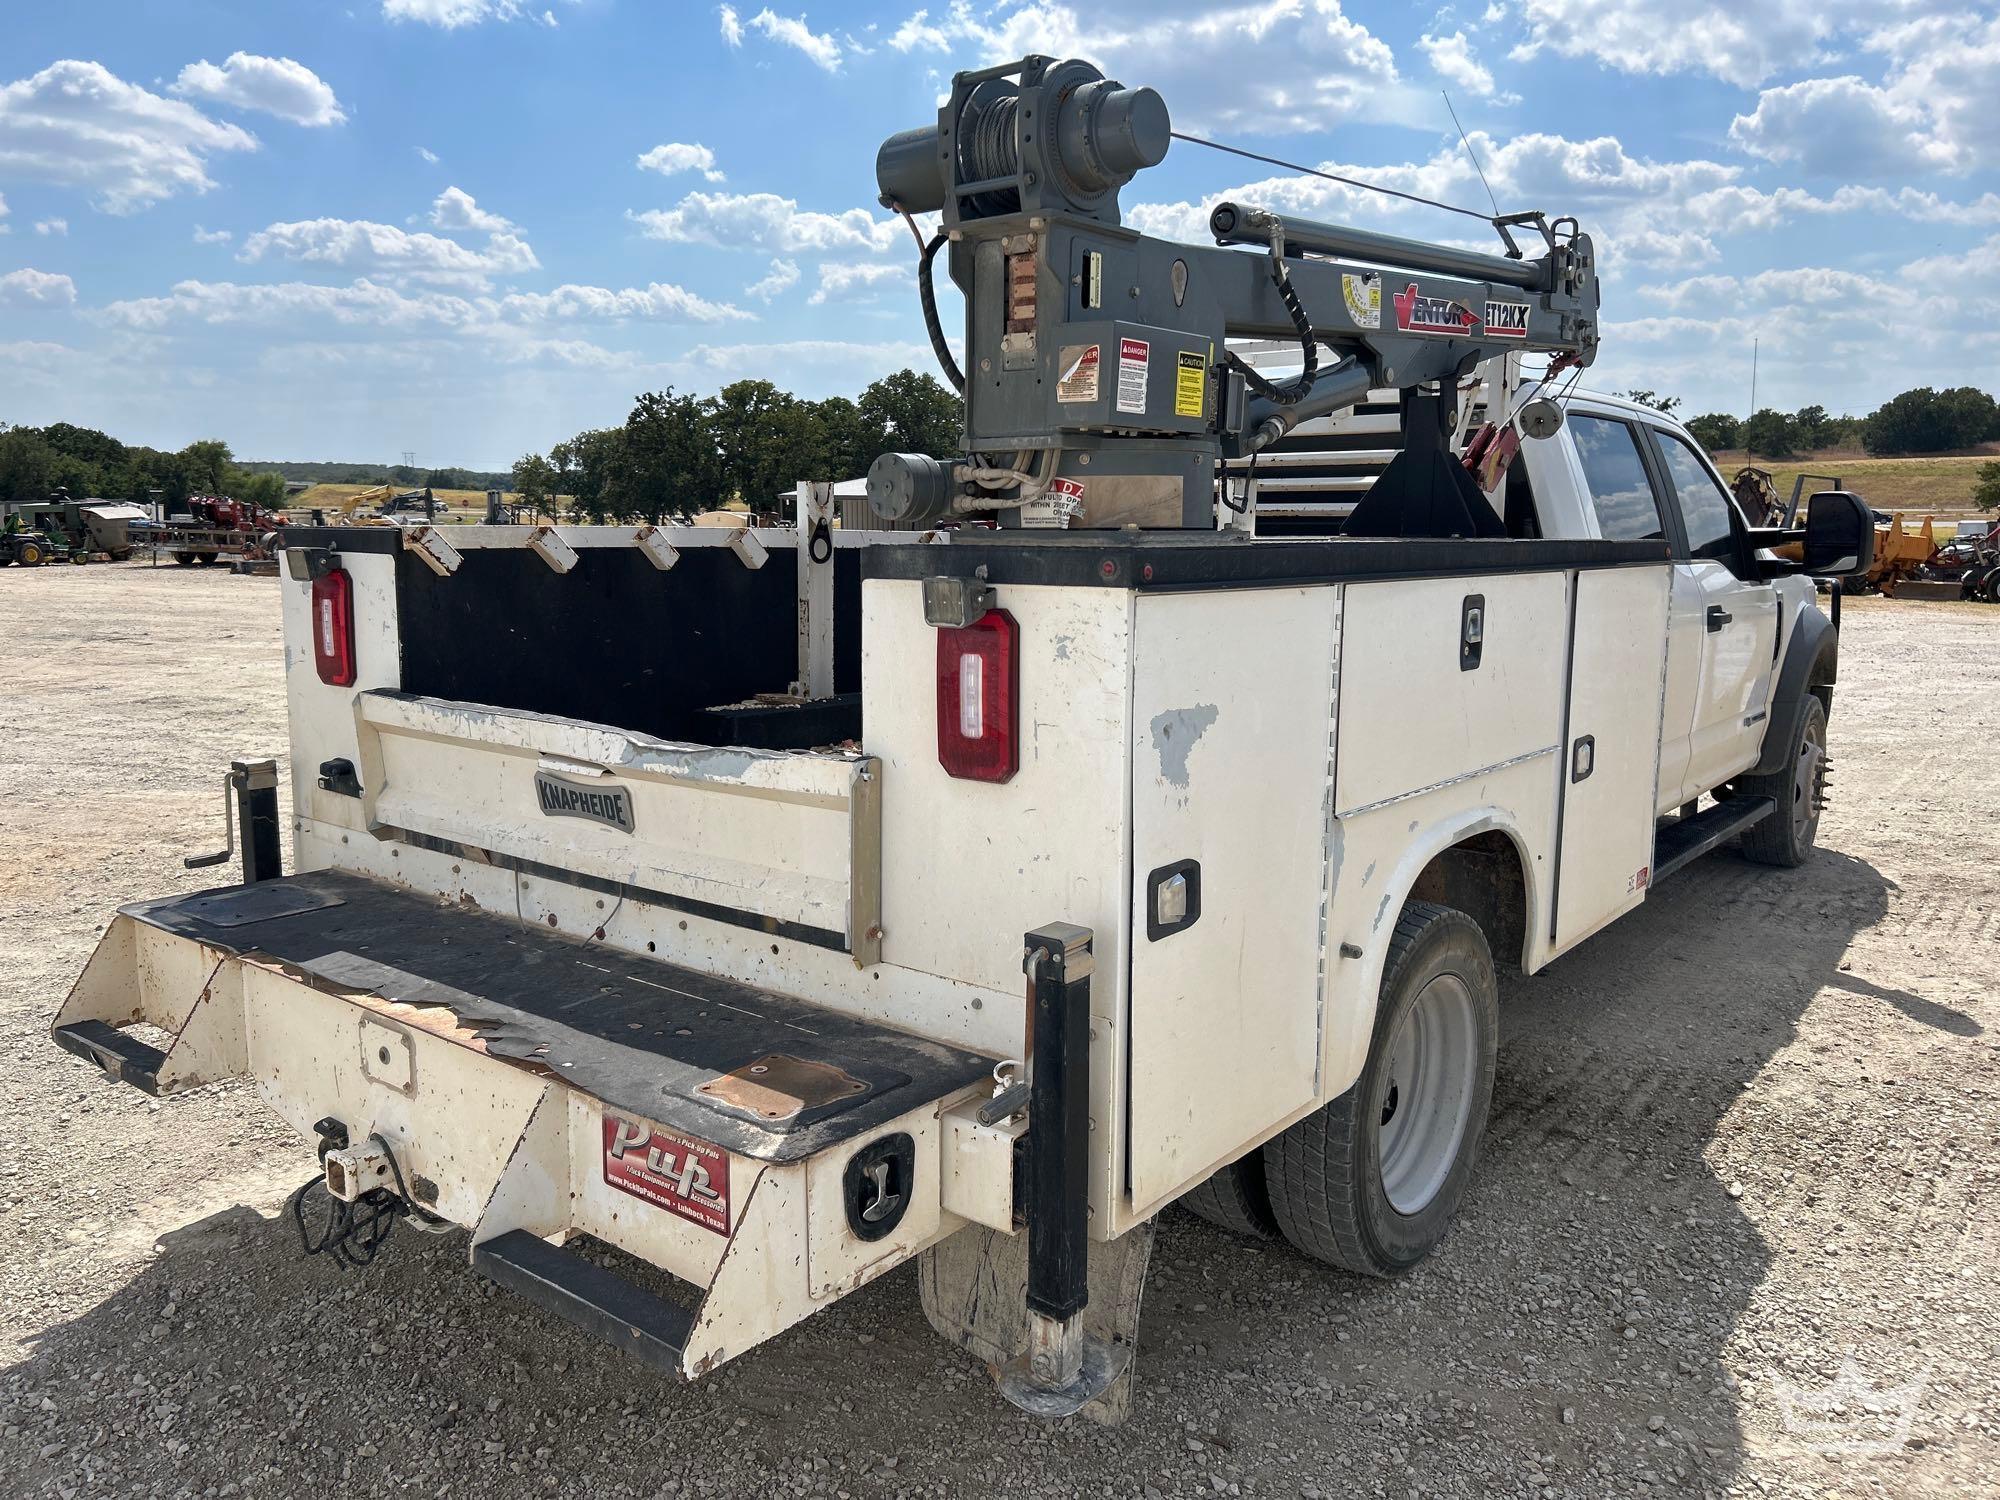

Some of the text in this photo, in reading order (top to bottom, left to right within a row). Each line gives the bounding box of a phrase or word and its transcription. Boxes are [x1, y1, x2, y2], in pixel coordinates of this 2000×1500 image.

[1485, 303, 1529, 328] ET12KX
[1127, 346, 1147, 357] DANGER
[1184, 357, 1204, 367] CAUTION
[539, 779, 626, 826] KNAPHEIDE
[681, 1138, 705, 1154] Pick-Up
[705, 1147, 720, 1160] Pals
[625, 1165, 641, 1177] Truck
[641, 1170, 671, 1189] Equipment
[608, 1174, 725, 1230] www.PickUpPals.com Lubbock, Texas
[690, 1193, 725, 1213] Accessories
